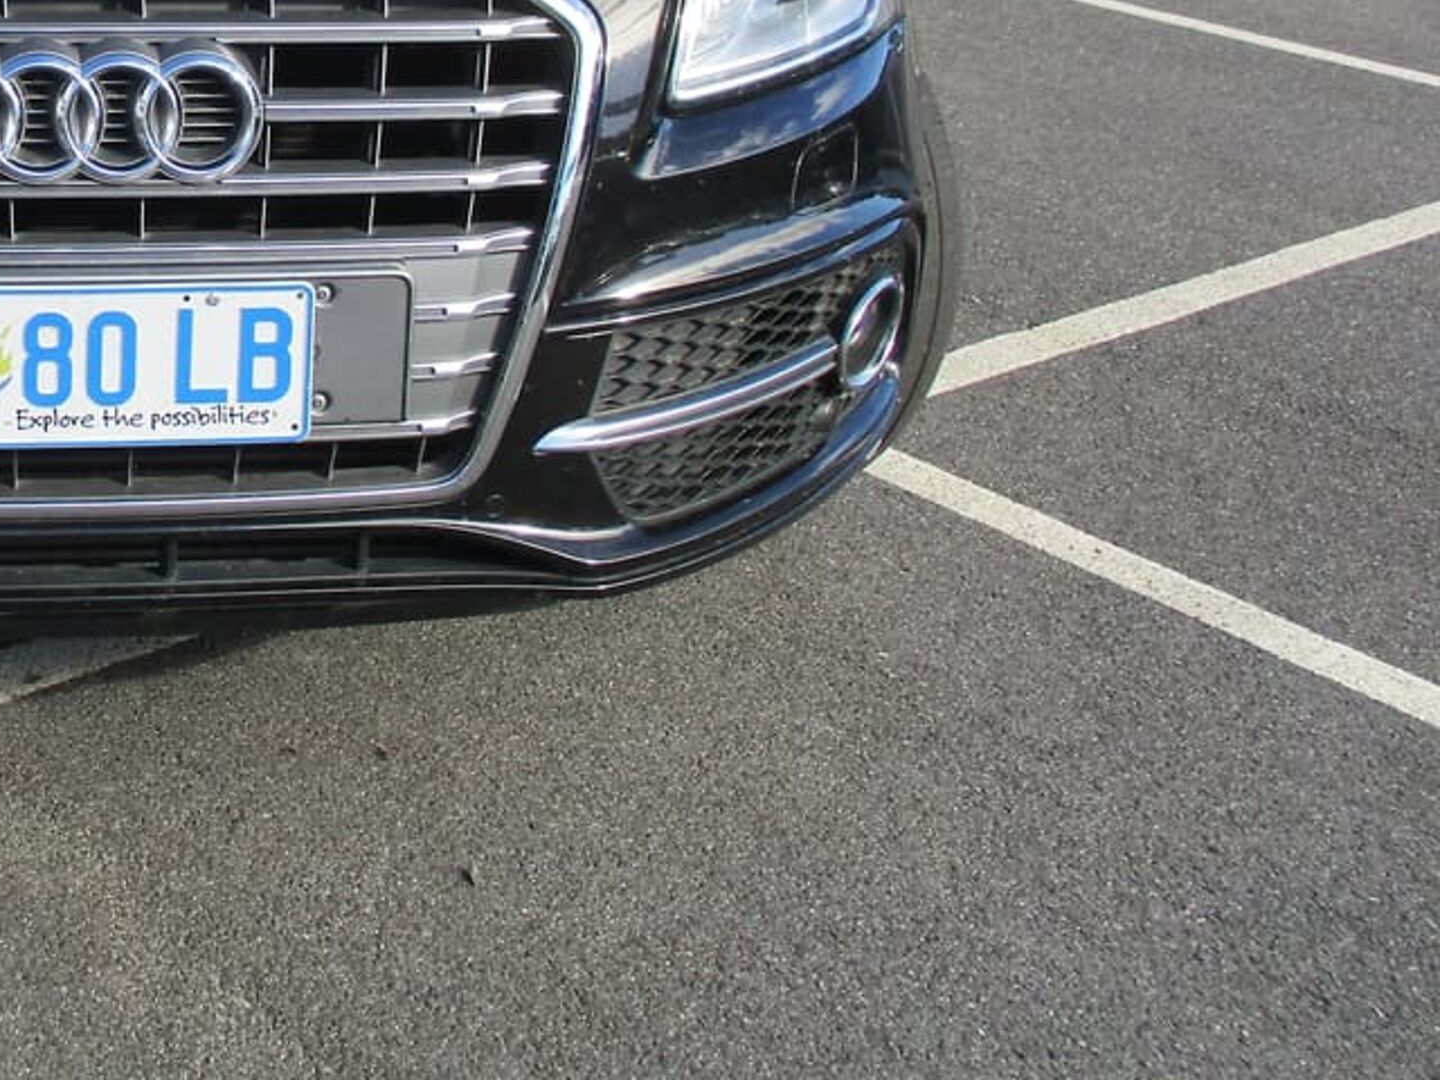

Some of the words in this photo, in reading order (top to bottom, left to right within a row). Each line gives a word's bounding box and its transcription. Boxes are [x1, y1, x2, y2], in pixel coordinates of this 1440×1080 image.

[23, 310, 137, 407] 80
[175, 307, 293, 403] LB
[17, 407, 95, 433] Explore
[103, 404, 144, 427] the
[151, 403, 270, 429] possibilities
